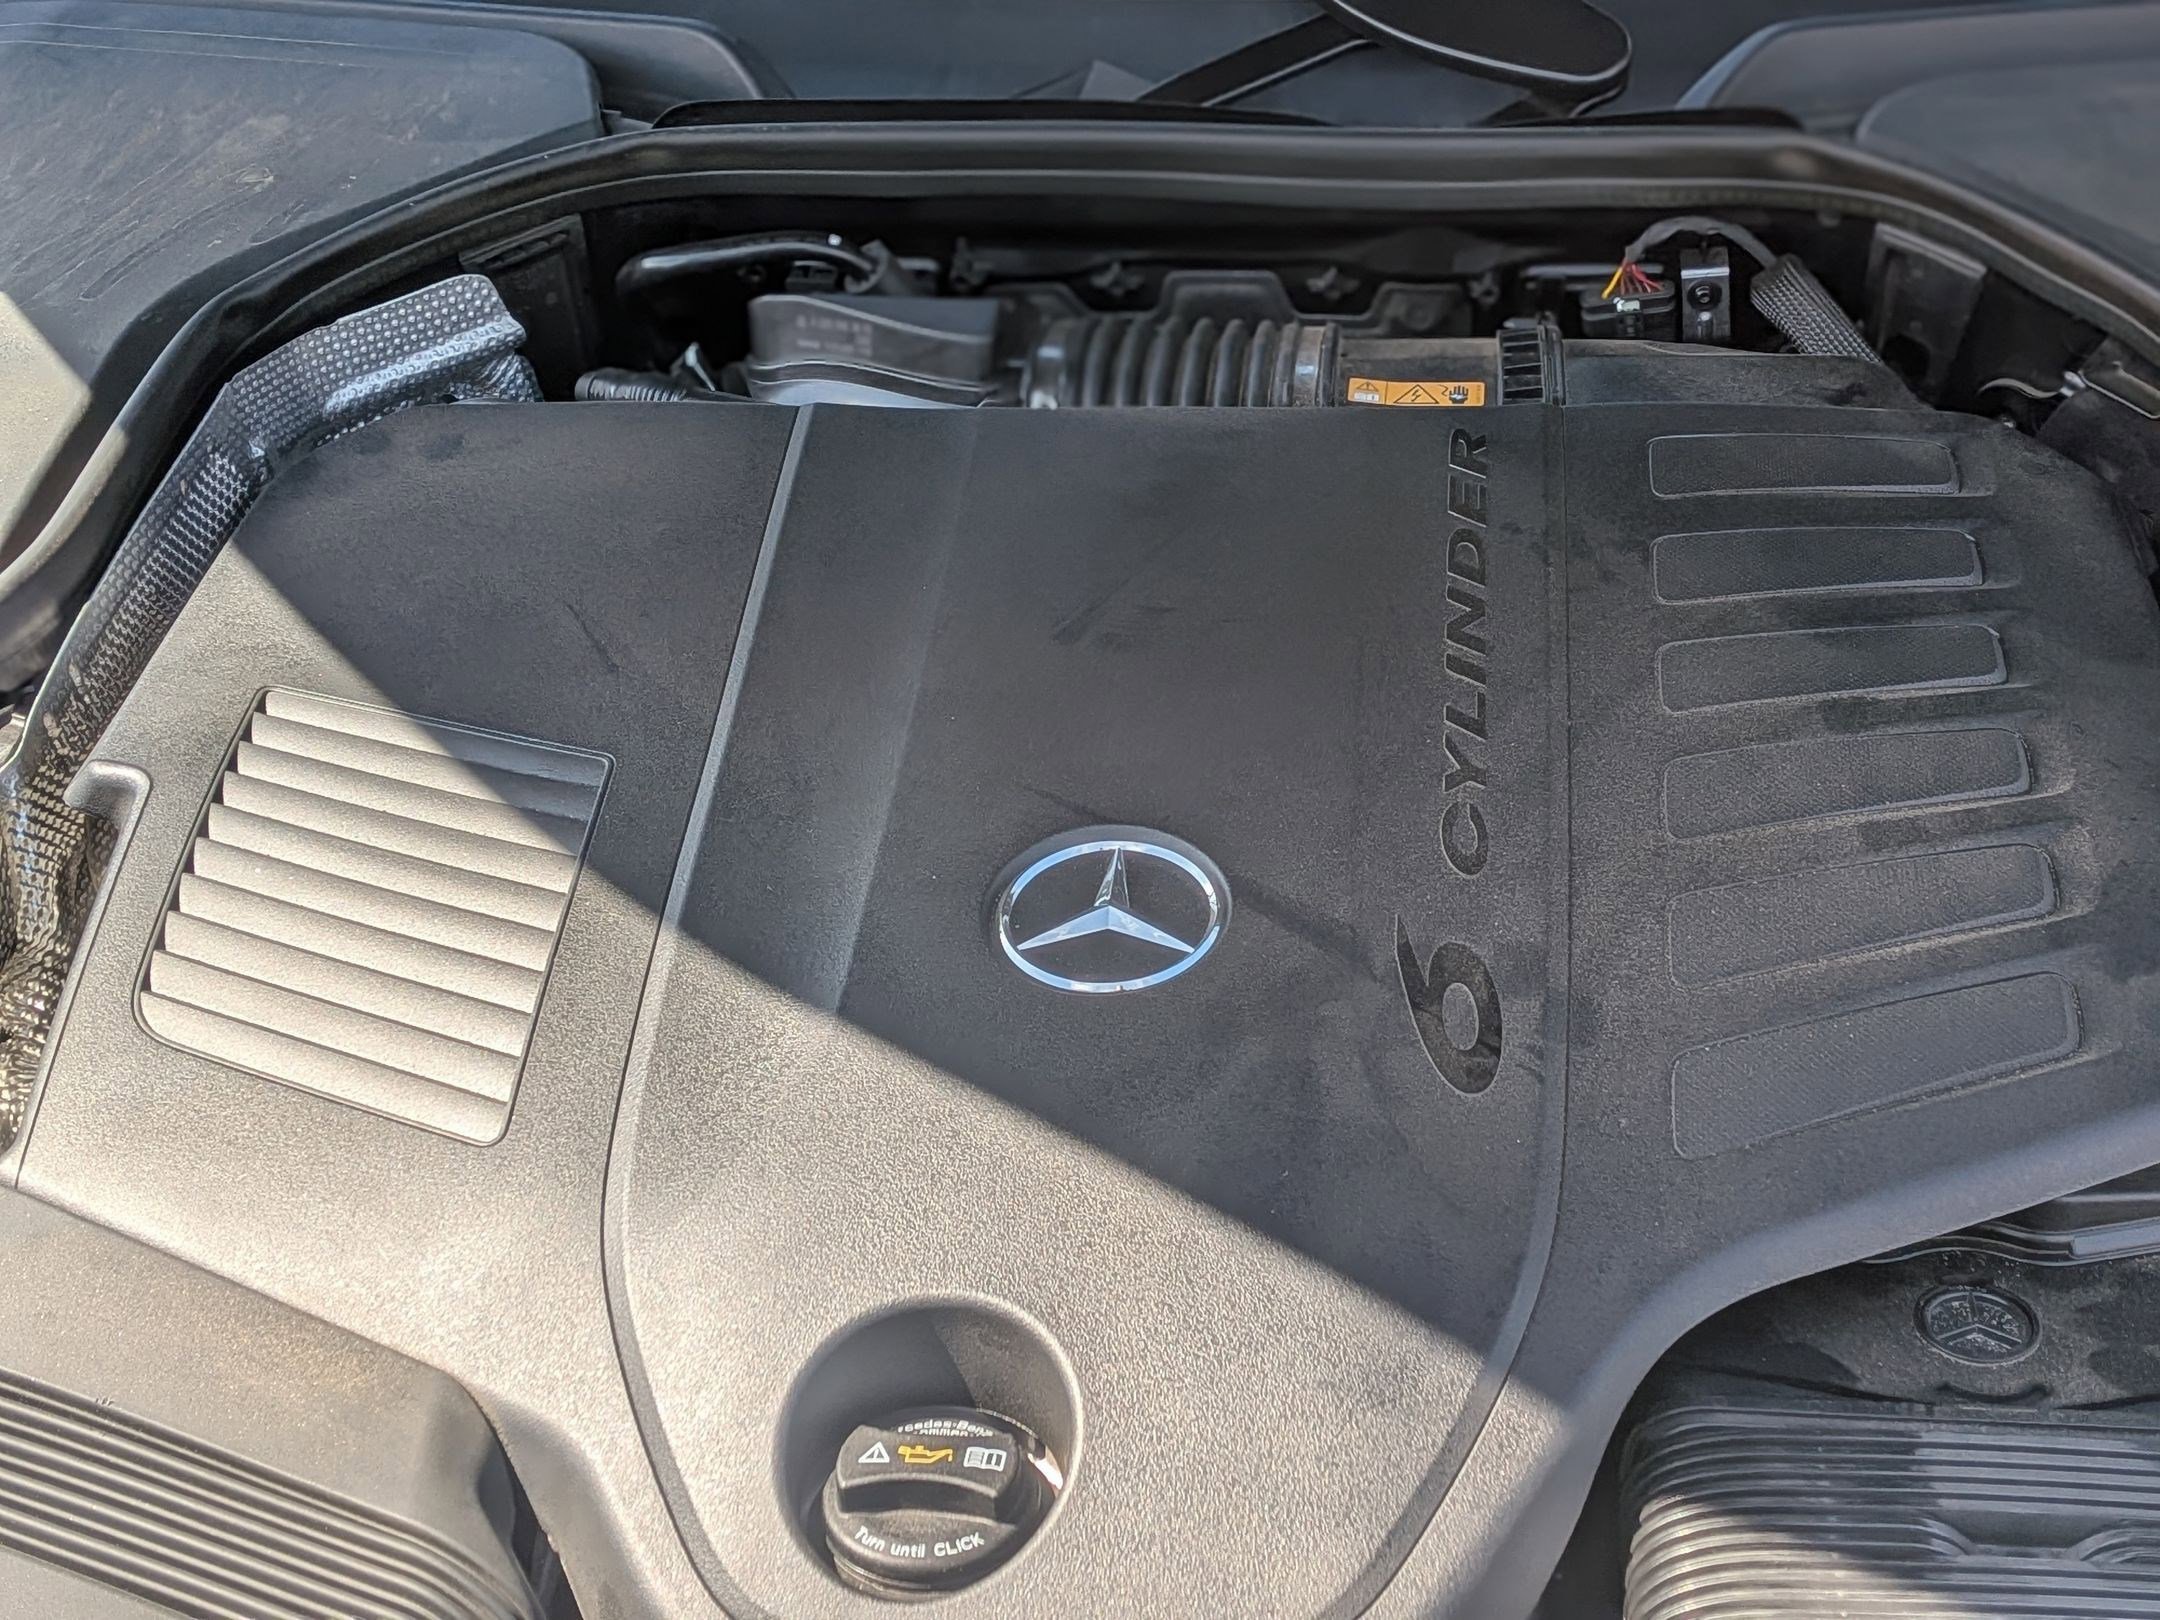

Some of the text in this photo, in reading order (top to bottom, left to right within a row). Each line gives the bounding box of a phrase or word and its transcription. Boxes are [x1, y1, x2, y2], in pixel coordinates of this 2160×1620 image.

[1395, 428, 1502, 1098] 6 CYLINDER
[854, 1525, 985, 1558] Turn until CLICK
